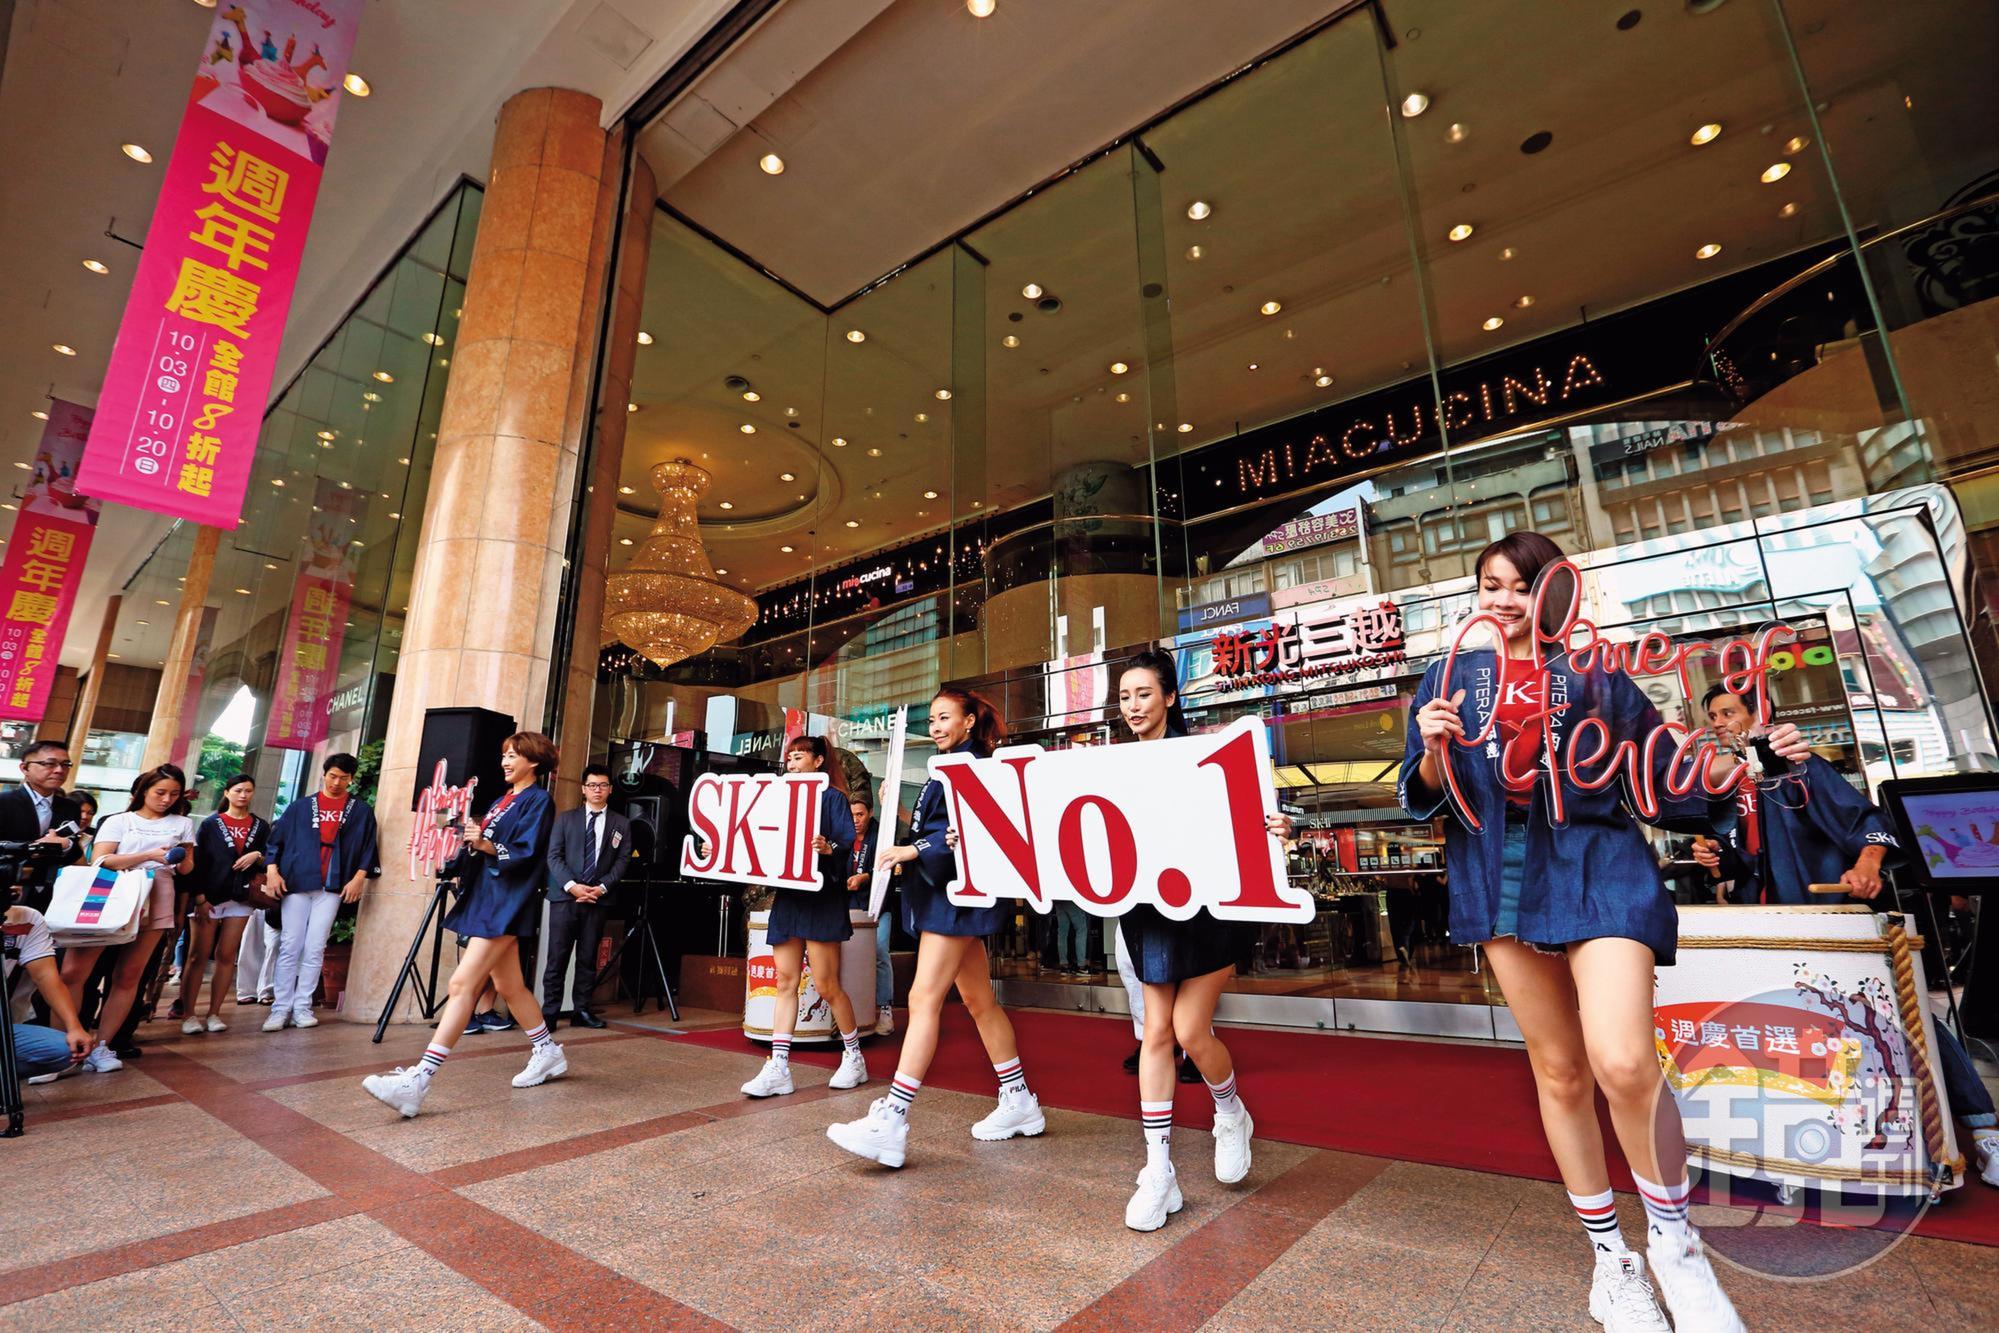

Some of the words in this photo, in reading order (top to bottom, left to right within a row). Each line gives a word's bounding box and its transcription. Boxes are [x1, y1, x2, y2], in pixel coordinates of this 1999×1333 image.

[164, 141, 289, 339] 週年慶
[176, 339, 244, 497] 全館8折起
[1238, 355, 1602, 492] MIACUCINA
[5, 527, 76, 626] 週年慶
[1211, 600, 1403, 677] 新光三越
[326, 686, 363, 715] CHANEL
[838, 714, 907, 738] CHANE
[1475, 667, 1491, 723] PITERA
[684, 779, 823, 883] SK-II
[1670, 1018, 1800, 1055] 週慶首選
[1009, 1082, 1027, 1094] FILA
